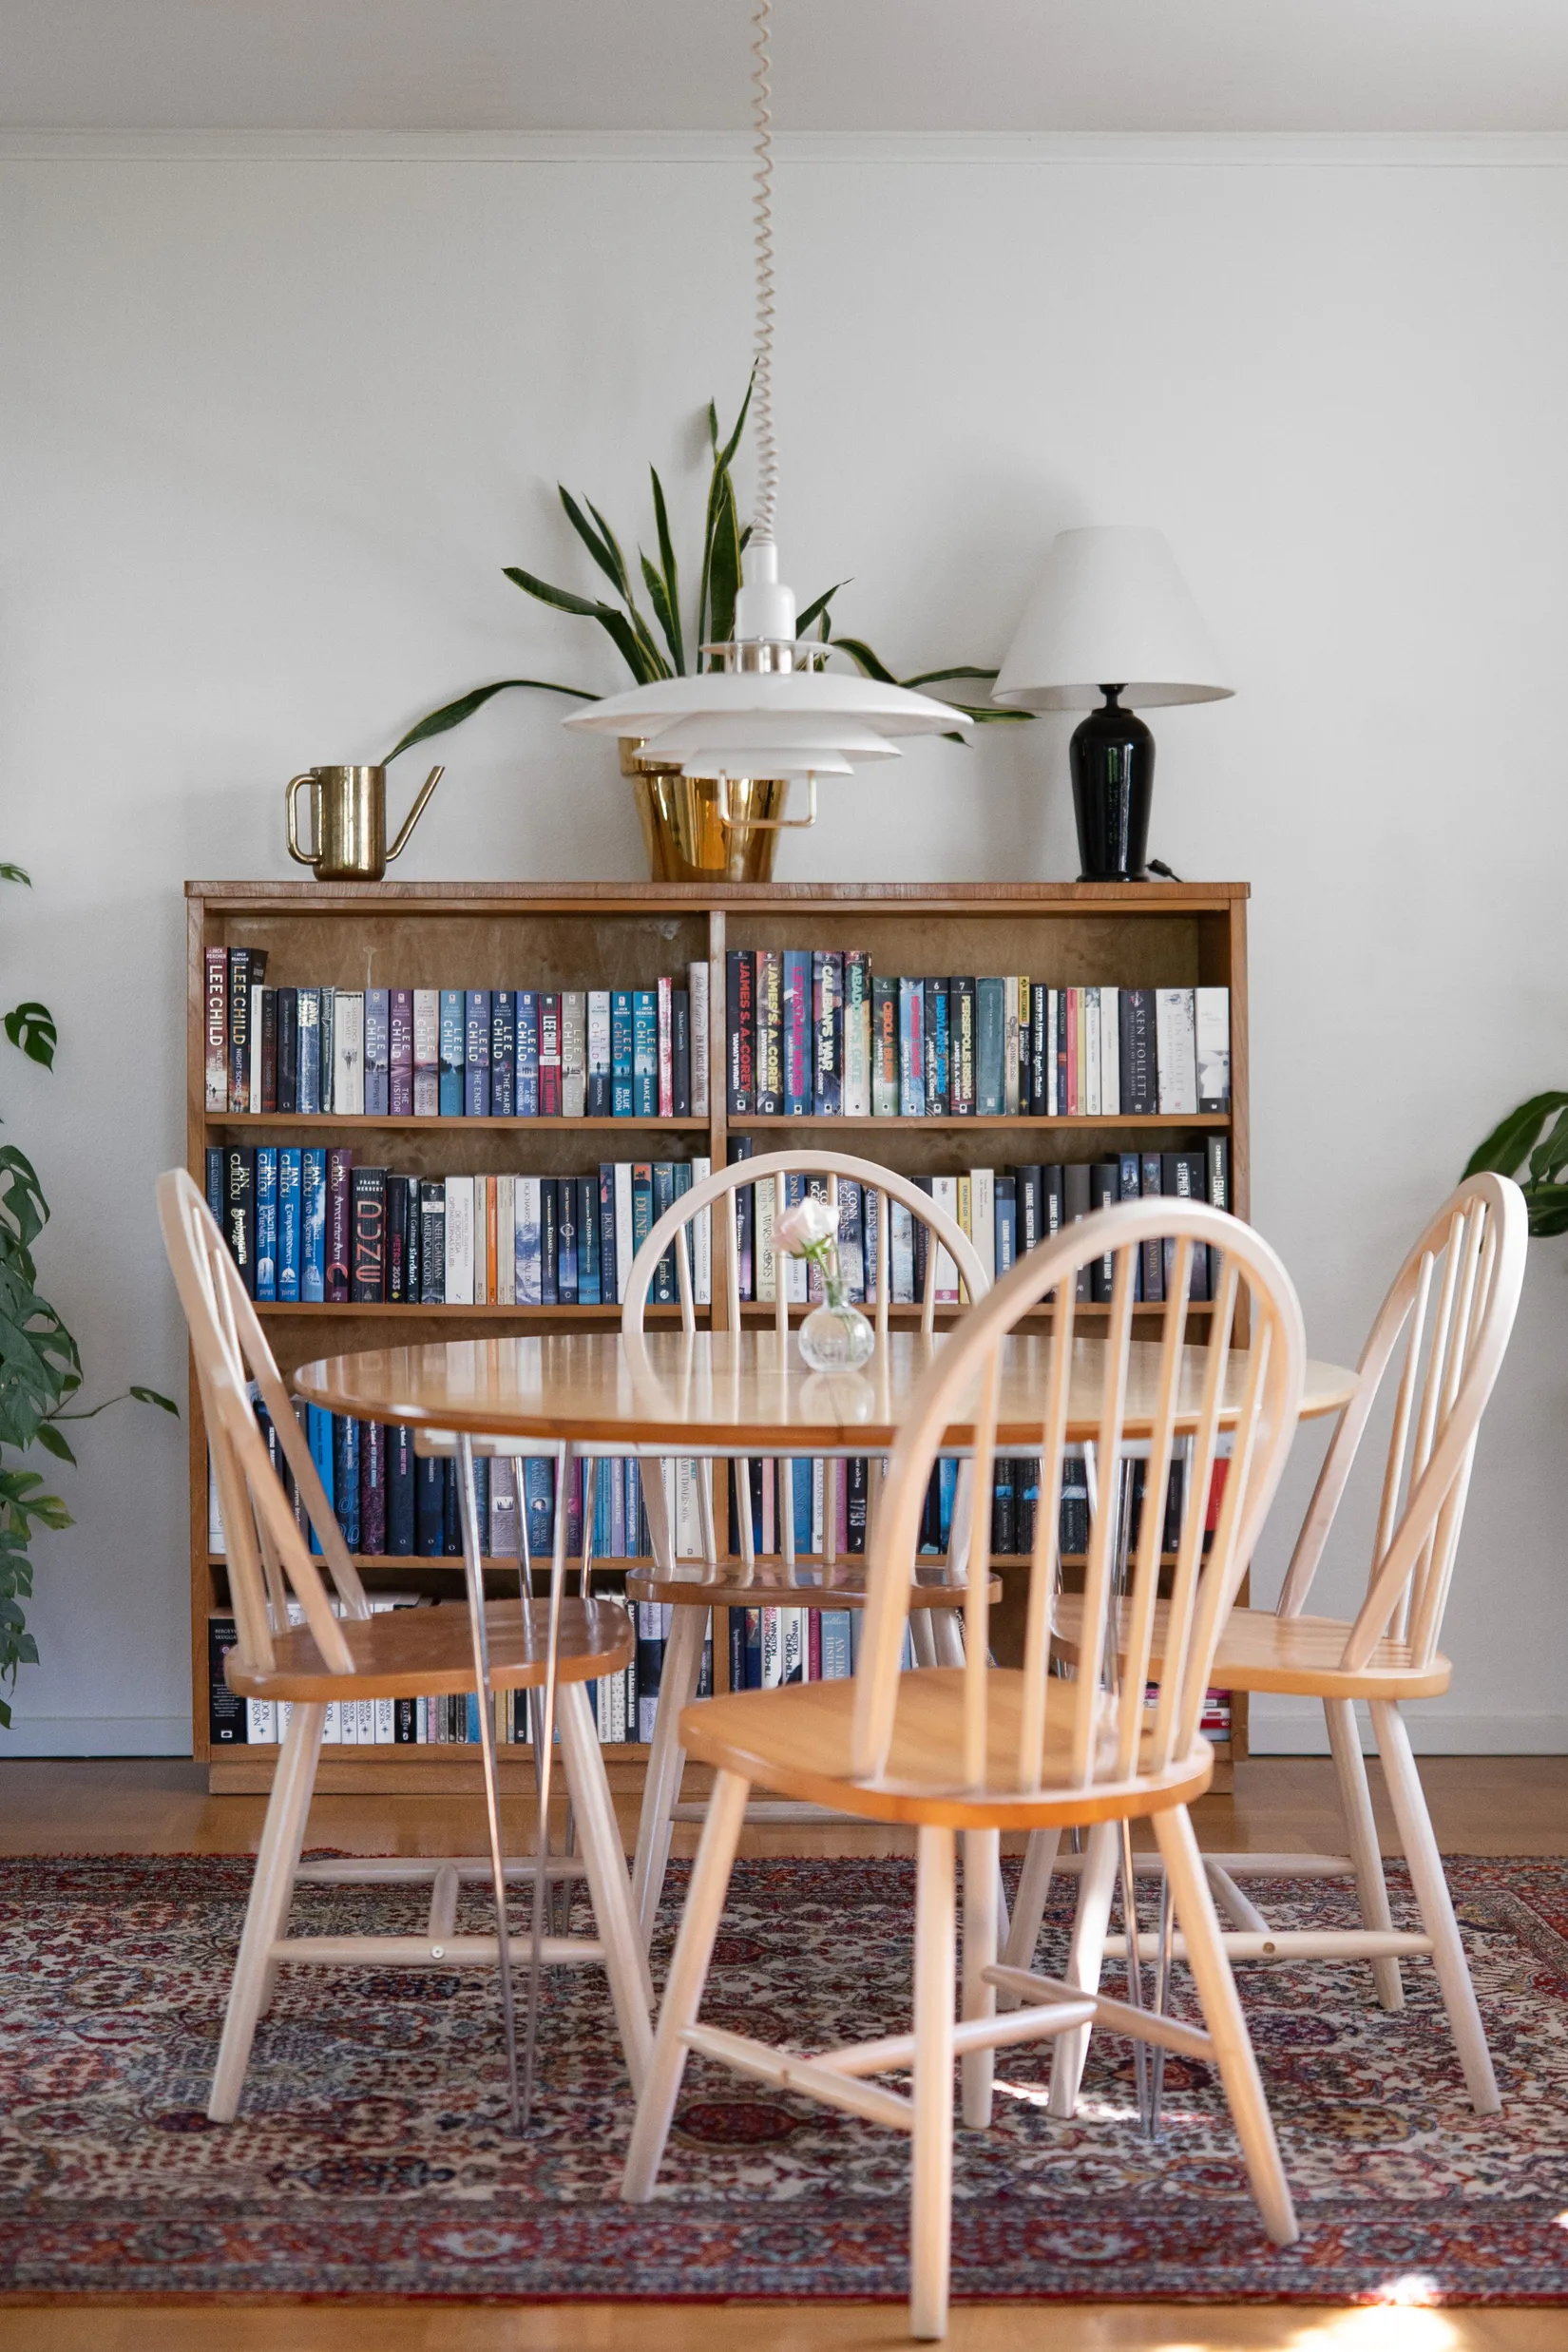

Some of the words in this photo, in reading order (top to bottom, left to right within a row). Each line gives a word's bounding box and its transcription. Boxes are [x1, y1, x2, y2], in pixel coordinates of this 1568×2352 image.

[209, 965, 223, 994] LEE
[233, 965, 246, 994] LEE
[739, 962, 751, 1008] JAMES
[768, 964, 778, 1009] JAMES
[792, 966, 804, 1045] LEVIATHAN
[822, 966, 833, 1038] CALIBAN'S
[851, 966, 863, 1039] ABADDON'S
[209, 997, 223, 1046] CHILD
[233, 997, 247, 1045] CHILD
[543, 1015, 558, 1030] LEE
[739, 1027, 751, 1042] A.
[768, 1029, 778, 1043] A.
[883, 1001, 894, 1044] CIBOLA
[936, 995, 947, 1055] BABYLON'S
[962, 995, 971, 1061] PERSEPOLIS
[1136, 1010, 1145, 1036] KEN
[367, 1019, 376, 1059] CHILD
[377, 1026, 386, 1050] LEE
[392, 1020, 402, 1059] CHILD
[402, 1027, 411, 1051] LEE
[416, 1020, 426, 1060] CHILD
[427, 1027, 435, 1052] LEE
[443, 1021, 453, 1060] CHILD
[453, 1028, 462, 1052] LEE
[468, 1022, 478, 1062] CHILD
[478, 1029, 488, 1054] LEE
[493, 1019, 504, 1060] CHILD
[503, 1026, 512, 1051] LEE
[517, 1022, 527, 1062] CHILD
[527, 1029, 536, 1054] LEE
[543, 1031, 558, 1056] CHILD
[564, 1022, 574, 1062] CHILD
[573, 1029, 582, 1054] LEE
[591, 1022, 601, 1061] CHILD
[600, 1029, 608, 1053] LEE
[614, 1022, 623, 1061] CHILD
[622, 1029, 631, 1053] LEE
[637, 1021, 646, 1061] CHILD
[646, 1028, 656, 1054] LEE
[696, 1035, 704, 1043] EN
[696, 1044, 705, 1073] KÄNSLIG
[739, 1045, 751, 1092] COREY
[768, 1046, 778, 1095] COREY
[822, 1042, 833, 1071] WAR
[1137, 1042, 1147, 1098] FOLLETT
[793, 1048, 804, 1097] WAKES
[936, 1058, 947, 1094] ASHES
[962, 1062, 972, 1100] RISING
[401, 1088, 410, 1104] THE
[494, 1085, 503, 1102] WAY
[643, 1102, 651, 1114] ME
[211, 1154, 220, 1170] NEIL
[230, 1153, 240, 1201] GUILLOU
[239, 1167, 250, 1188] JAN
[258, 1153, 268, 1197] GUILLOU
[266, 1167, 277, 1186] JAN
[280, 1154, 290, 1198] GUILLOU
[288, 1167, 298, 1187] JAN
[303, 1153, 314, 1197] GUILLOU
[312, 1166, 322, 1186] JAN
[331, 1155, 339, 1192] GUILLOU
[337, 1166, 347, 1182] JAN
[211, 1170, 220, 1197] GAIMAN
[524, 1182, 533, 1196] DICK
[1176, 1162, 1190, 1196] STEPHEN
[1213, 1176, 1225, 1208] LEHANE
[334, 1195, 345, 1221] Arvet
[524, 1197, 533, 1232] HARRISON
[636, 1197, 648, 1238] DUNE
[847, 1191, 858, 1220] CONN
[231, 1208, 247, 1265] Brobyggarna
[334, 1222, 343, 1242] efter
[423, 1214, 432, 1259] AMERICAN
[434, 1221, 443, 1241] NEIL
[604, 1213, 613, 1240] DUNE
[334, 1242, 344, 1260] Arn
[392, 1234, 401, 1265] METRO
[434, 1242, 443, 1279] GAIMAN
[392, 1266, 401, 1291] 2033
[408, 1247, 417, 1285] Stardust
[423, 1260, 432, 1286] GODS
[813, 1264, 822, 1291] PLAINS
[850, 1498, 867, 1526] 1793
[532, 1516, 541, 1548] SWORDS
[770, 1621, 778, 1656] WINSTON
